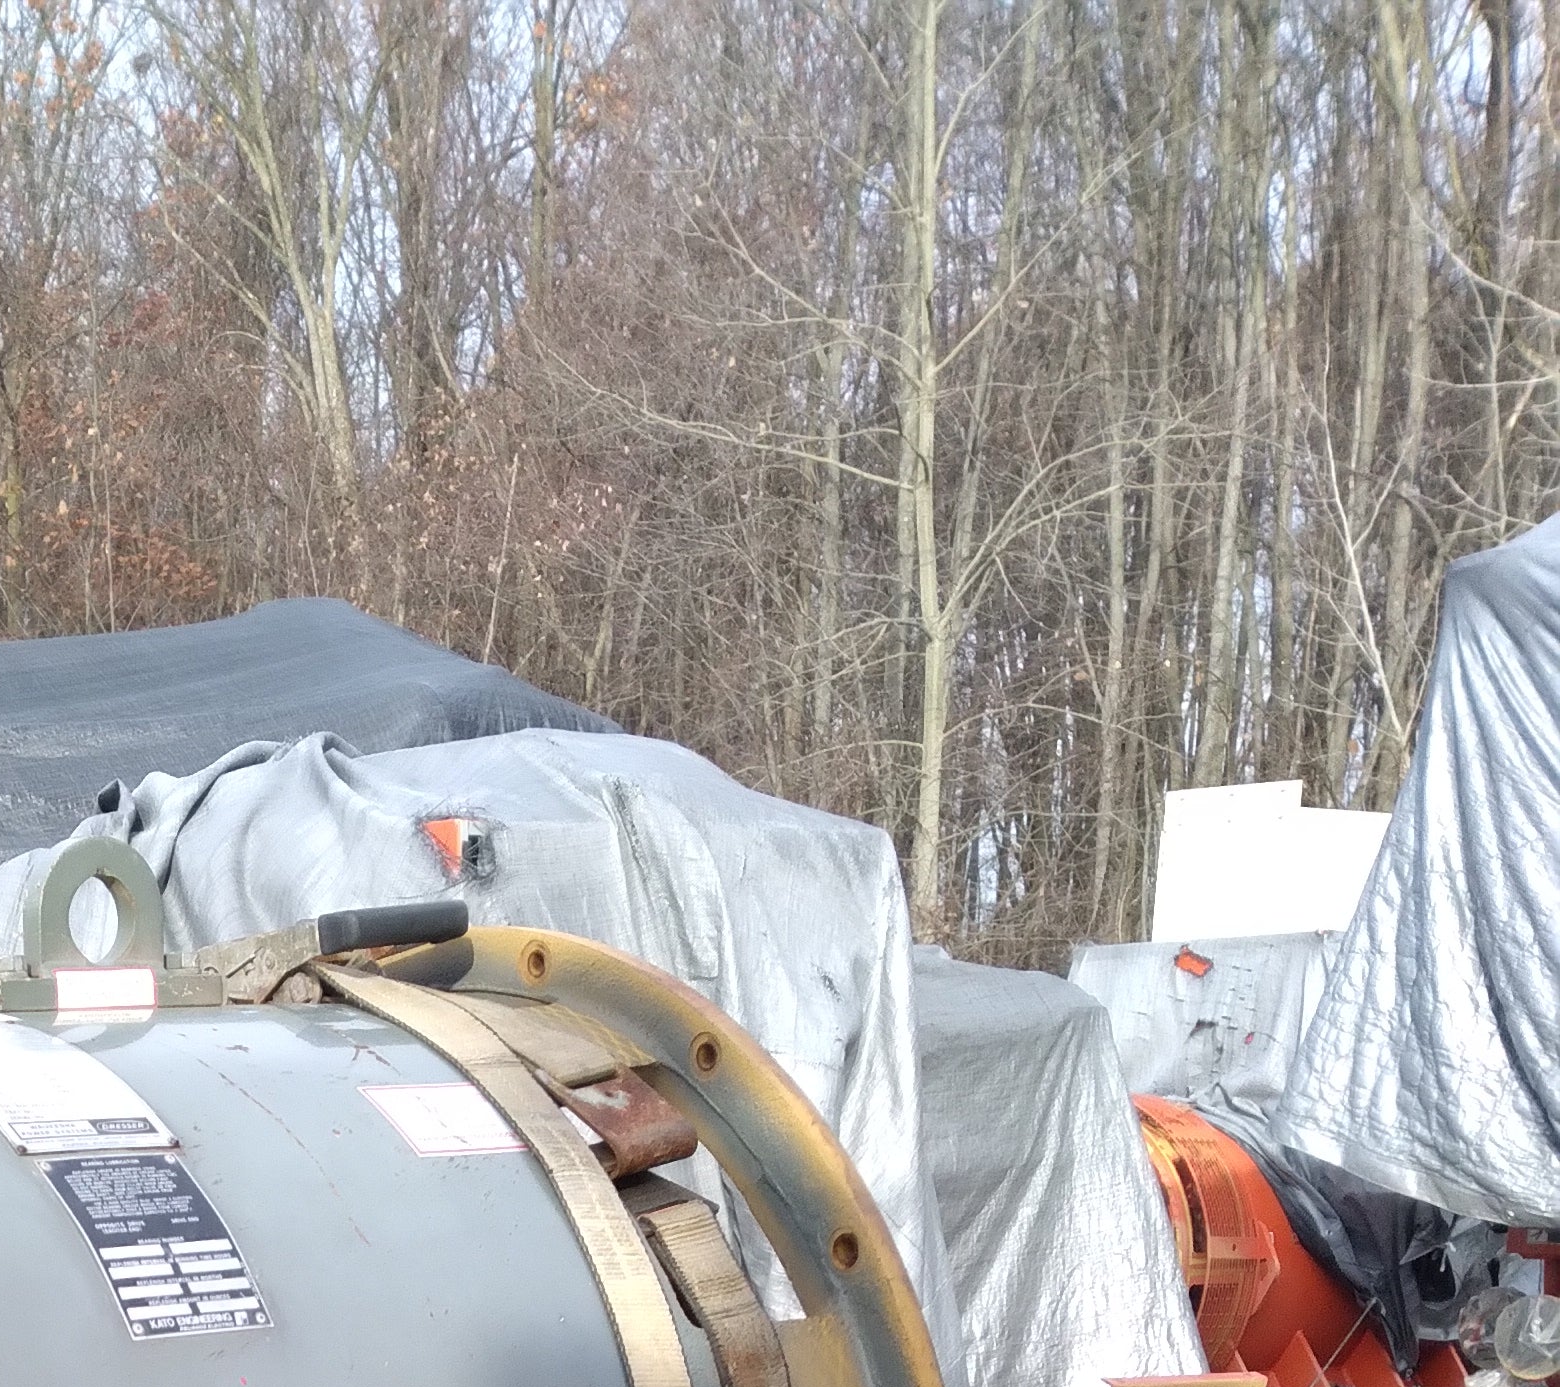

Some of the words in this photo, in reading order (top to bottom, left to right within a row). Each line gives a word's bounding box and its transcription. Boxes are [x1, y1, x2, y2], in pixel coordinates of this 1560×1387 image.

[101, 1121, 144, 1130] DRESSER
[149, 1318, 176, 1329] KATO
[176, 1313, 233, 1326] ENGINEERING
